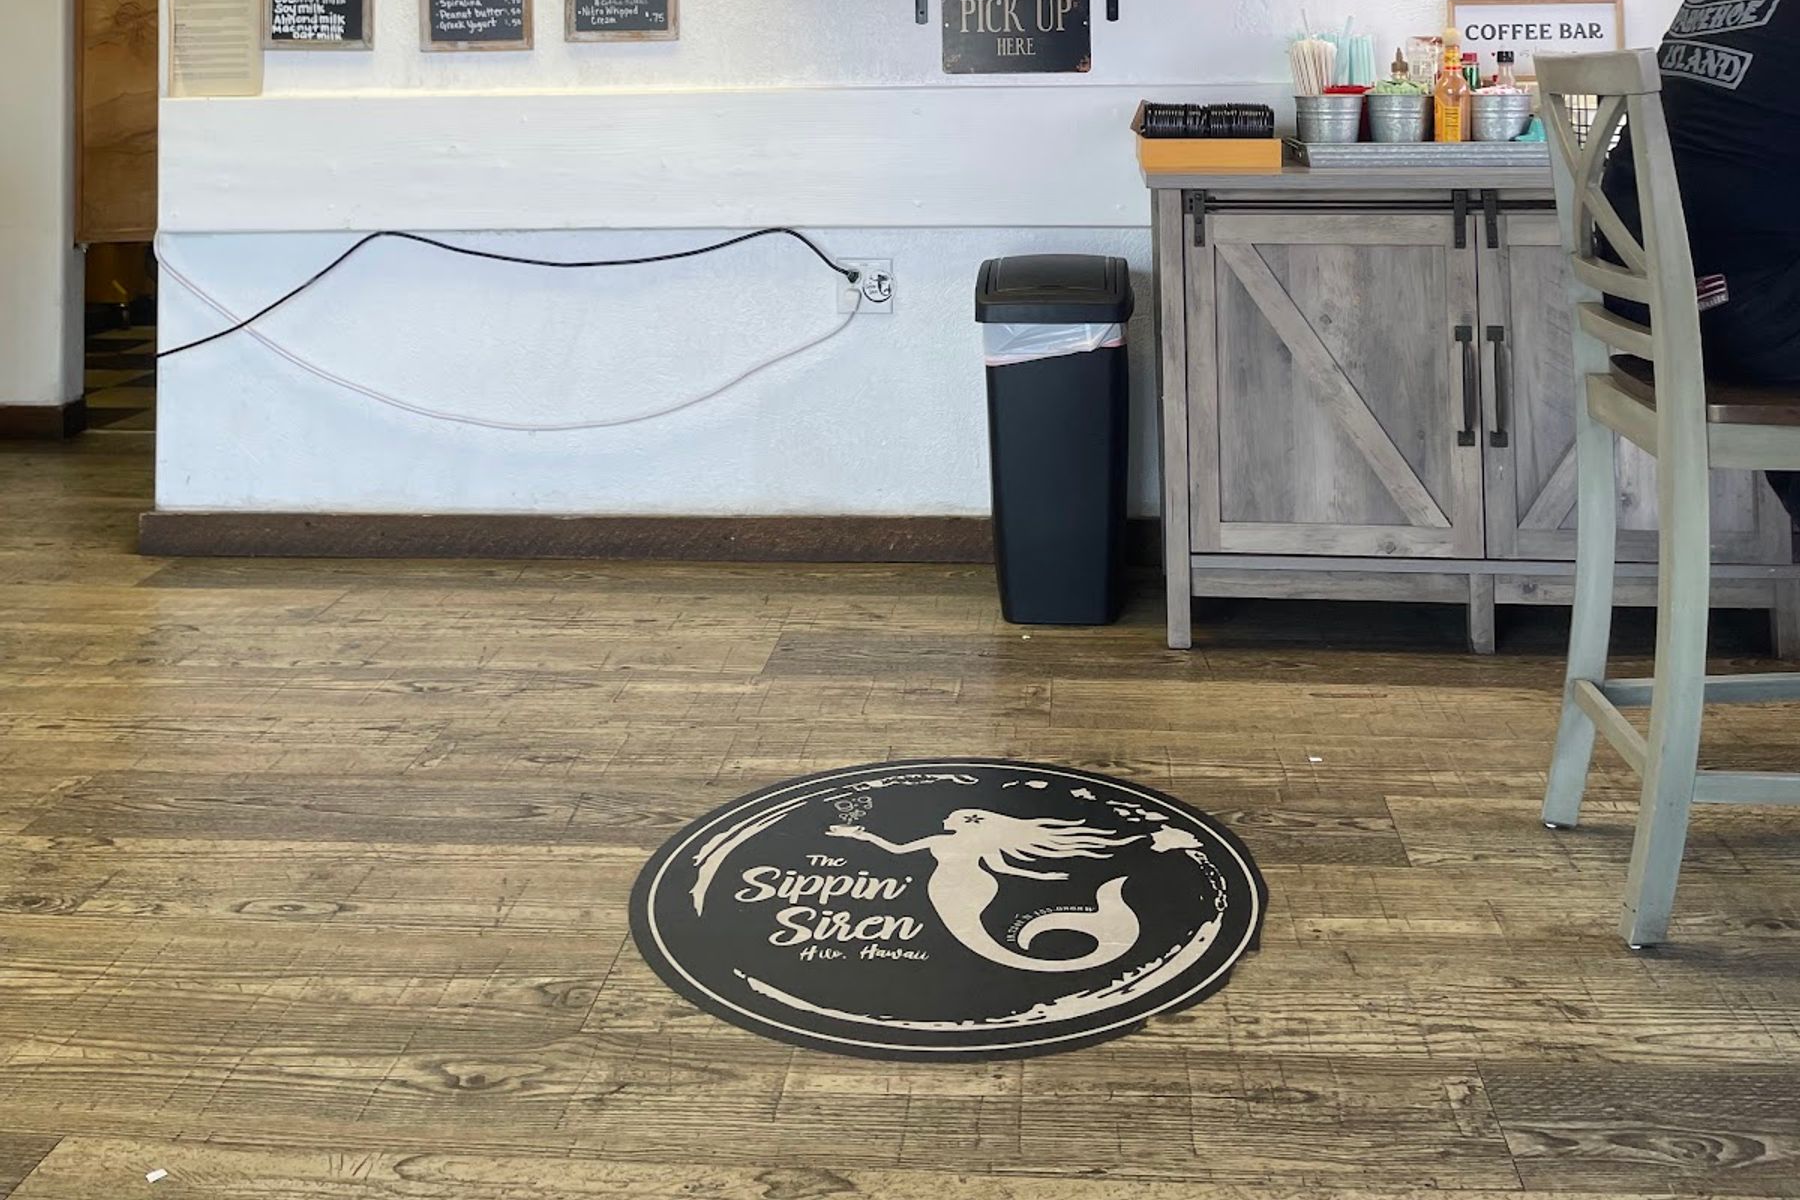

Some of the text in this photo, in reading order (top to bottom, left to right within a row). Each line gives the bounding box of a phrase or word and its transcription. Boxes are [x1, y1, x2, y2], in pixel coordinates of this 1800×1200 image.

[275, 3, 297, 16] Soy
[439, 8, 472, 20] Peanut
[1464, 22, 1604, 41] COFFEE BAR
[997, 37, 1036, 56] HERE
[1662, 44, 1741, 82] ISLAND
[806, 854, 848, 867] The
[768, 906, 924, 947] Siren
[860, 943, 930, 960] Hawaii
